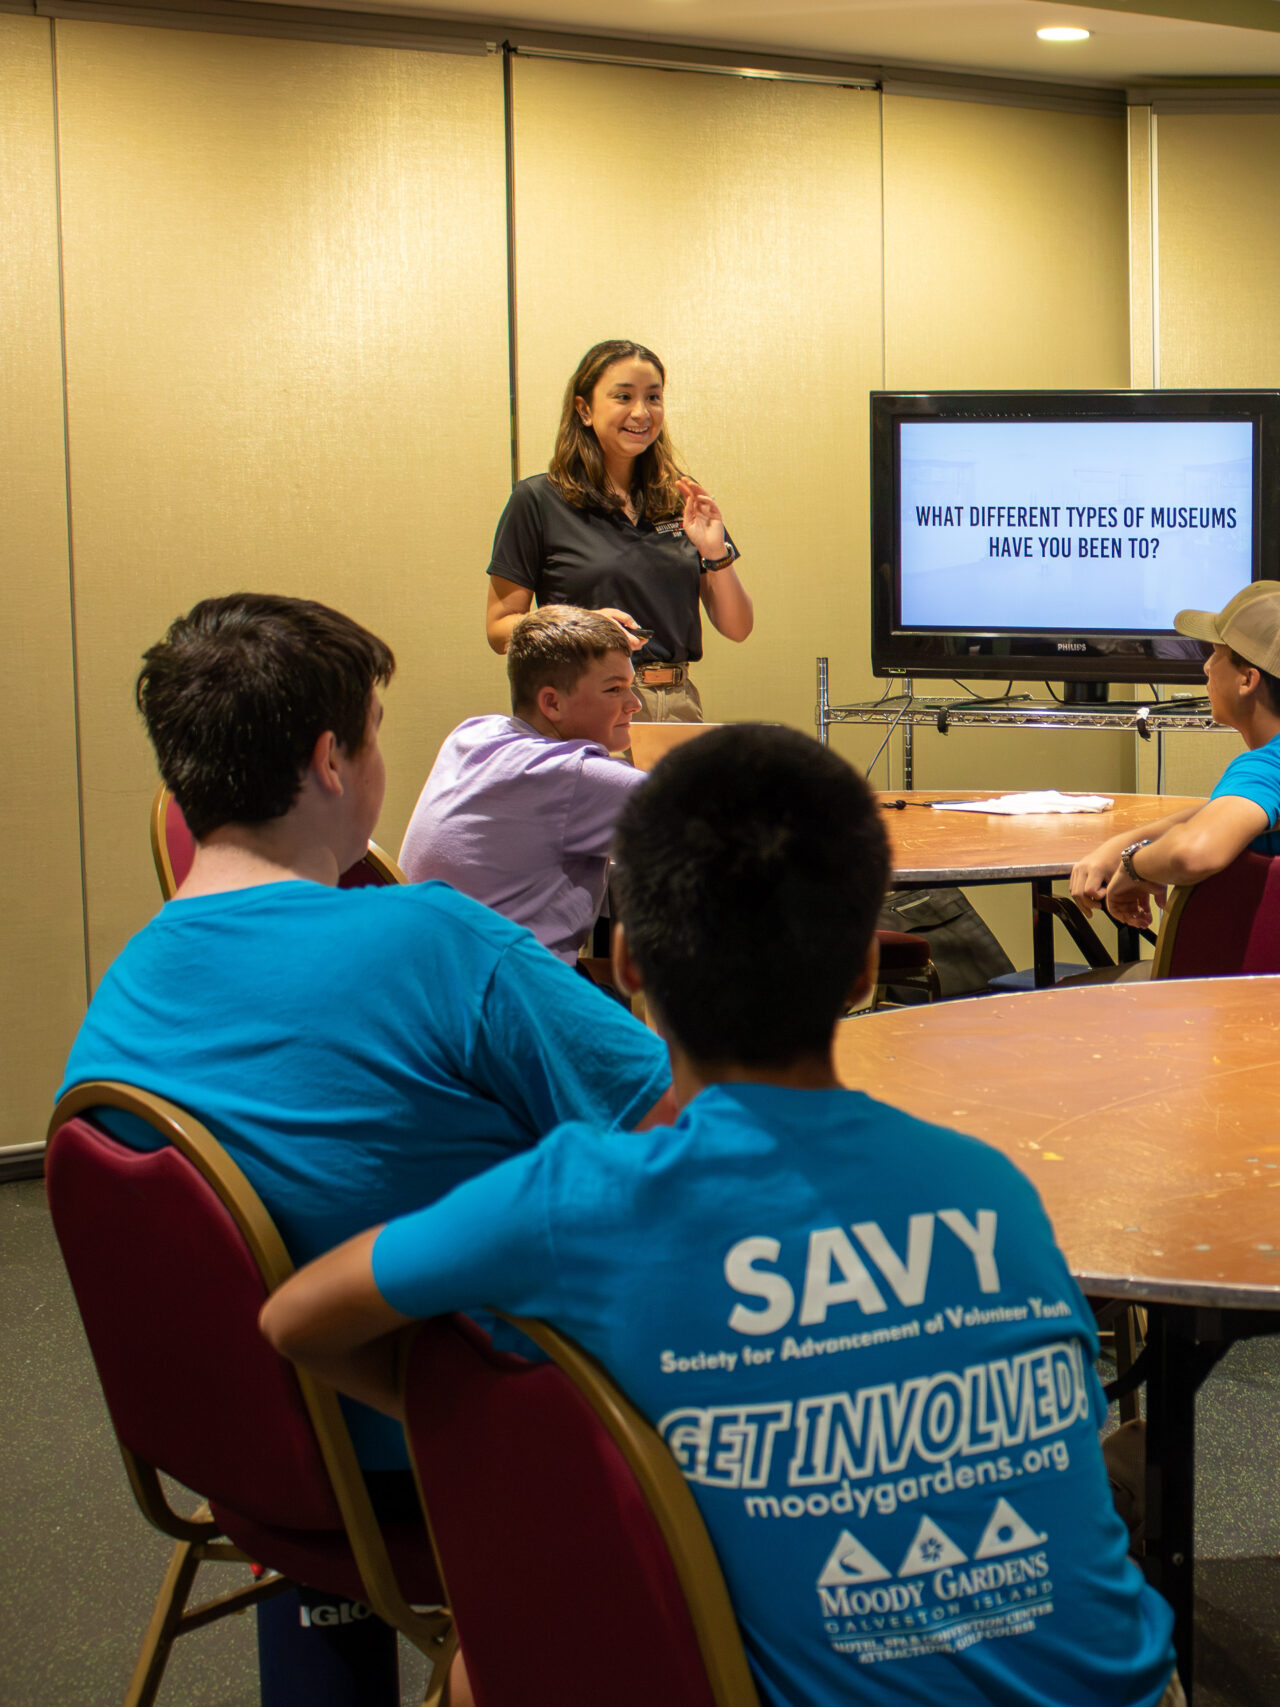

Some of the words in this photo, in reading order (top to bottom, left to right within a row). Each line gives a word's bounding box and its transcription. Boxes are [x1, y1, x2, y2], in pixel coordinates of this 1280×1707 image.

[916, 506, 964, 527] WHAT
[969, 506, 1061, 527] DIFFERENT
[1066, 506, 1118, 528] TYPES
[1123, 507, 1145, 528] OF
[1151, 507, 1237, 529] MUSEUMS
[989, 537, 1033, 558] HAVE
[1038, 537, 1072, 558] YOU
[1078, 537, 1122, 559] BEEN
[1128, 538, 1160, 559] TO?
[1057, 643, 1087, 652] PHILIPS
[724, 1208, 1000, 1336] SAVY
[660, 1350, 736, 1374] Society
[742, 1346, 774, 1366] for
[781, 1315, 920, 1361] Advancement
[924, 1314, 944, 1335] of
[945, 1304, 1028, 1329] Volunteer
[1029, 1297, 1072, 1318] Youth
[656, 1402, 793, 1489] GET
[788, 1337, 1089, 1487] INVOLVED!
[744, 1440, 1069, 1518] moodygardens.org
[817, 1580, 925, 1617] MOODY
[933, 1551, 1049, 1600] GARDENS
[824, 1602, 960, 1634] GALVESTON
[974, 1581, 1053, 1611] ISLAND
[300, 1602, 373, 1628] IGLO
